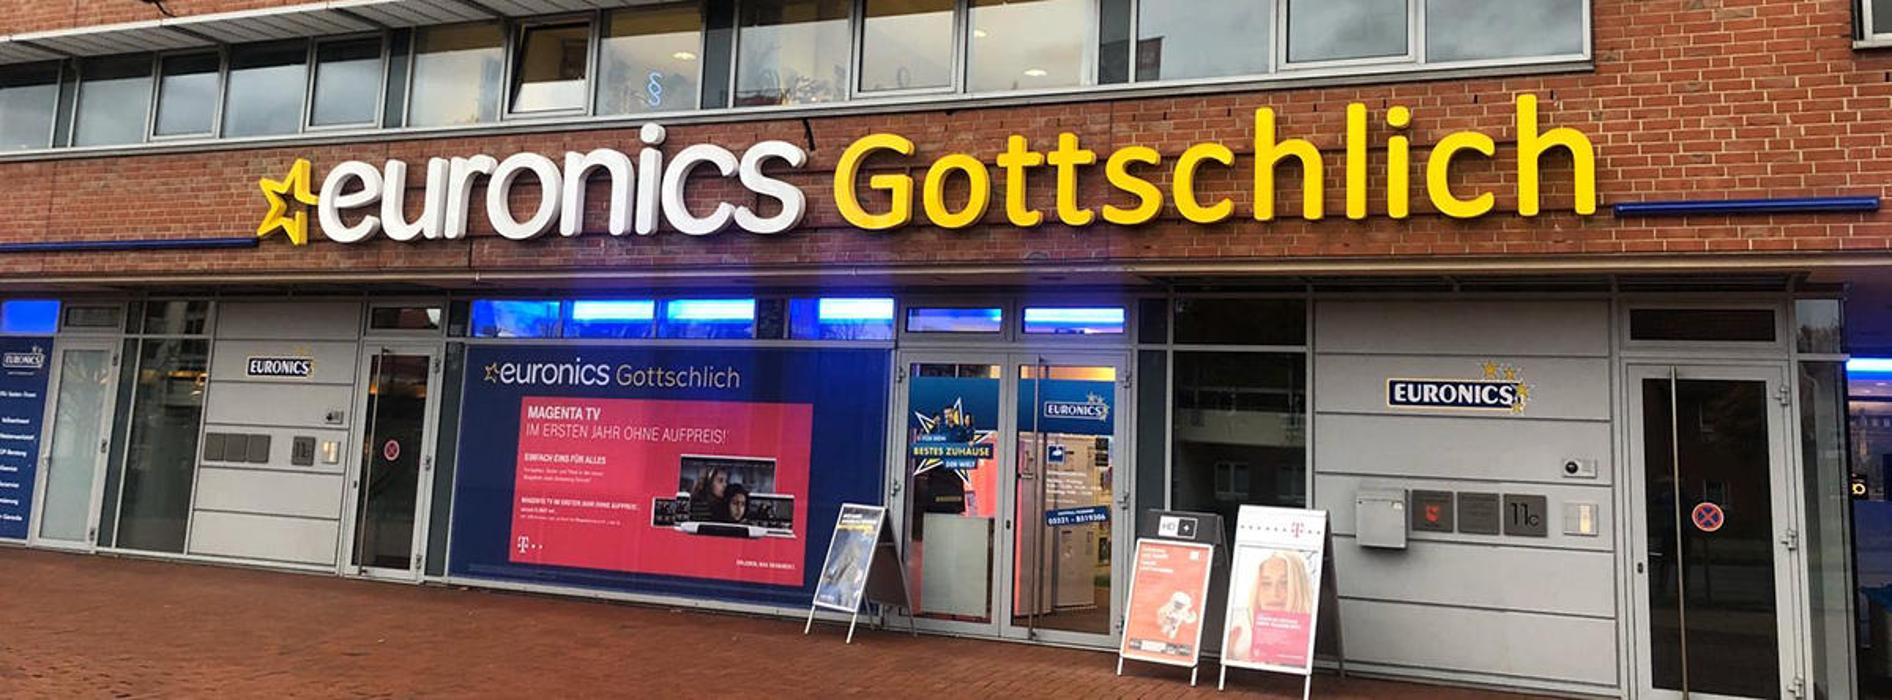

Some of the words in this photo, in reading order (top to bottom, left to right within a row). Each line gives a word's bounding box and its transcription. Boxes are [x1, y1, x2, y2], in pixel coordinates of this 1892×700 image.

[318, 123, 807, 243] euronics
[833, 94, 1597, 230] Gottschlich
[250, 360, 310, 374] EURONICS
[500, 357, 610, 386] euronics
[616, 364, 740, 388] Gottschlich
[1394, 384, 1513, 404] EURONICS
[528, 406, 583, 420] MAGENTA
[586, 407, 601, 420] TV
[1048, 405, 1101, 416] EURONICS
[526, 423, 540, 437] IM
[543, 424, 588, 438] ERSTEN
[591, 425, 620, 440] JAHR
[623, 426, 659, 442] OHNE
[913, 447, 944, 456] BESTES
[946, 447, 990, 456] ZUHAUSE
[586, 456, 606, 465] ALLES
[1510, 502, 1540, 527] 11c
